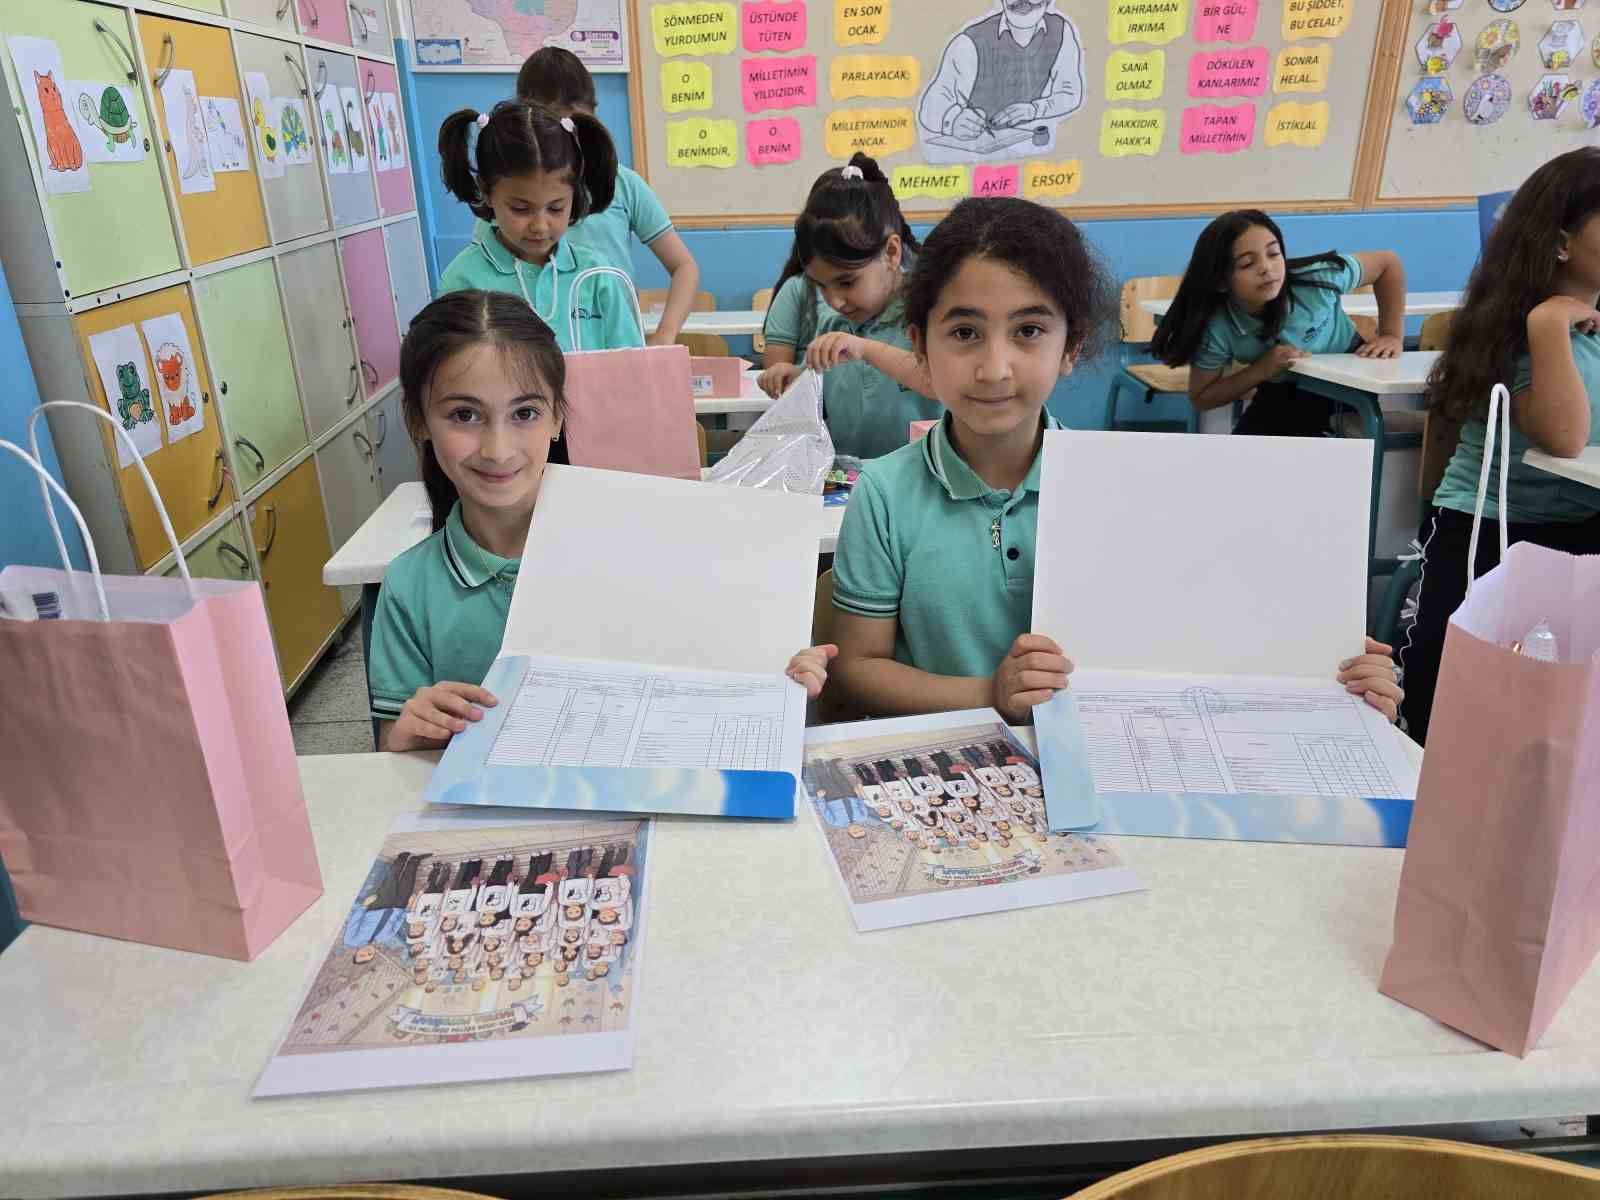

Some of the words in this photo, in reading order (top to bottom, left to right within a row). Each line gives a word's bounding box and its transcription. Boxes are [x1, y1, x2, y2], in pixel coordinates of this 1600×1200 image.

[843, 8, 858, 18] EN
[860, 5, 882, 17] SON
[1117, 3, 1178, 16] KAHRAMAN
[1203, 6, 1221, 17] BİR
[1289, 1, 1306, 12] BU
[663, 13, 724, 28] SÖNMEDEN
[749, 11, 799, 24] ÜSTÜNDE
[1127, 22, 1165, 34] IRKIMA
[1216, 25, 1231, 35] NE
[1290, 20, 1307, 31] BU
[1307, 17, 1342, 30] CELAL?
[664, 31, 727, 47] YURDUMUN
[758, 31, 792, 43] TÜTEN
[1121, 62, 1149, 73] SANA
[1206, 60, 1254, 72] DÖKÜLEN
[1283, 56, 1319, 67] SONRA
[681, 74, 690, 84] O
[749, 67, 809, 83] MİLLETİMİN
[1116, 80, 1152, 92] OLMAZ
[1197, 77, 1260, 89] KANLARIMIZ
[671, 91, 705, 103] BENİM
[1203, 117, 1237, 126] TAPAN
[699, 129, 708, 140] O
[769, 126, 777, 137] O
[1189, 132, 1247, 145] MİLLETİMİN
[758, 143, 791, 156] BENİM
[899, 175, 960, 188] MEHMET
[980, 178, 1012, 192] AKİF
[1031, 172, 1074, 187] ERSOY
